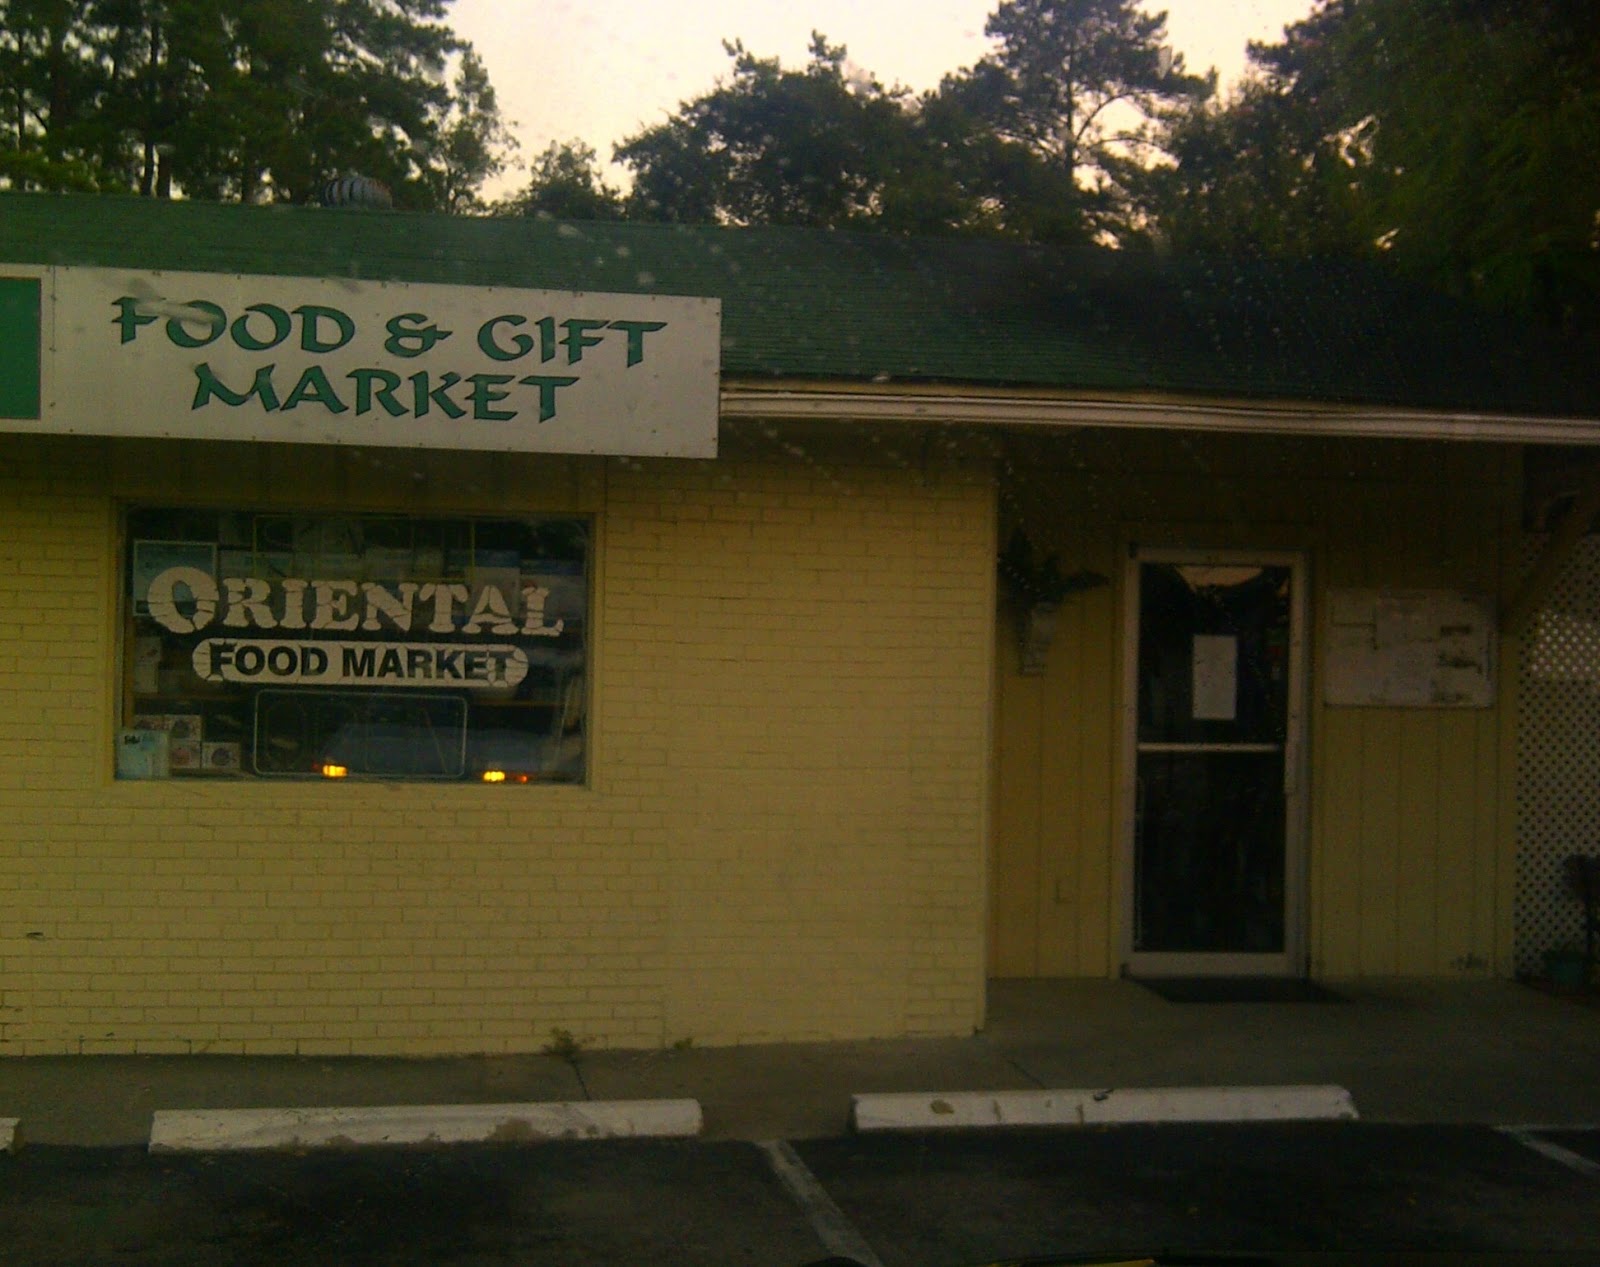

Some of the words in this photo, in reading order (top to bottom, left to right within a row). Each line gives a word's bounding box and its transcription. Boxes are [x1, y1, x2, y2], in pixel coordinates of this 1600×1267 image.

[111, 296, 356, 353] FOOD
[384, 313, 452, 357] &
[477, 315, 667, 367] GIFT
[192, 363, 579, 422] MARKET
[209, 642, 328, 680] FOOD
[342, 648, 513, 682] MARKET
